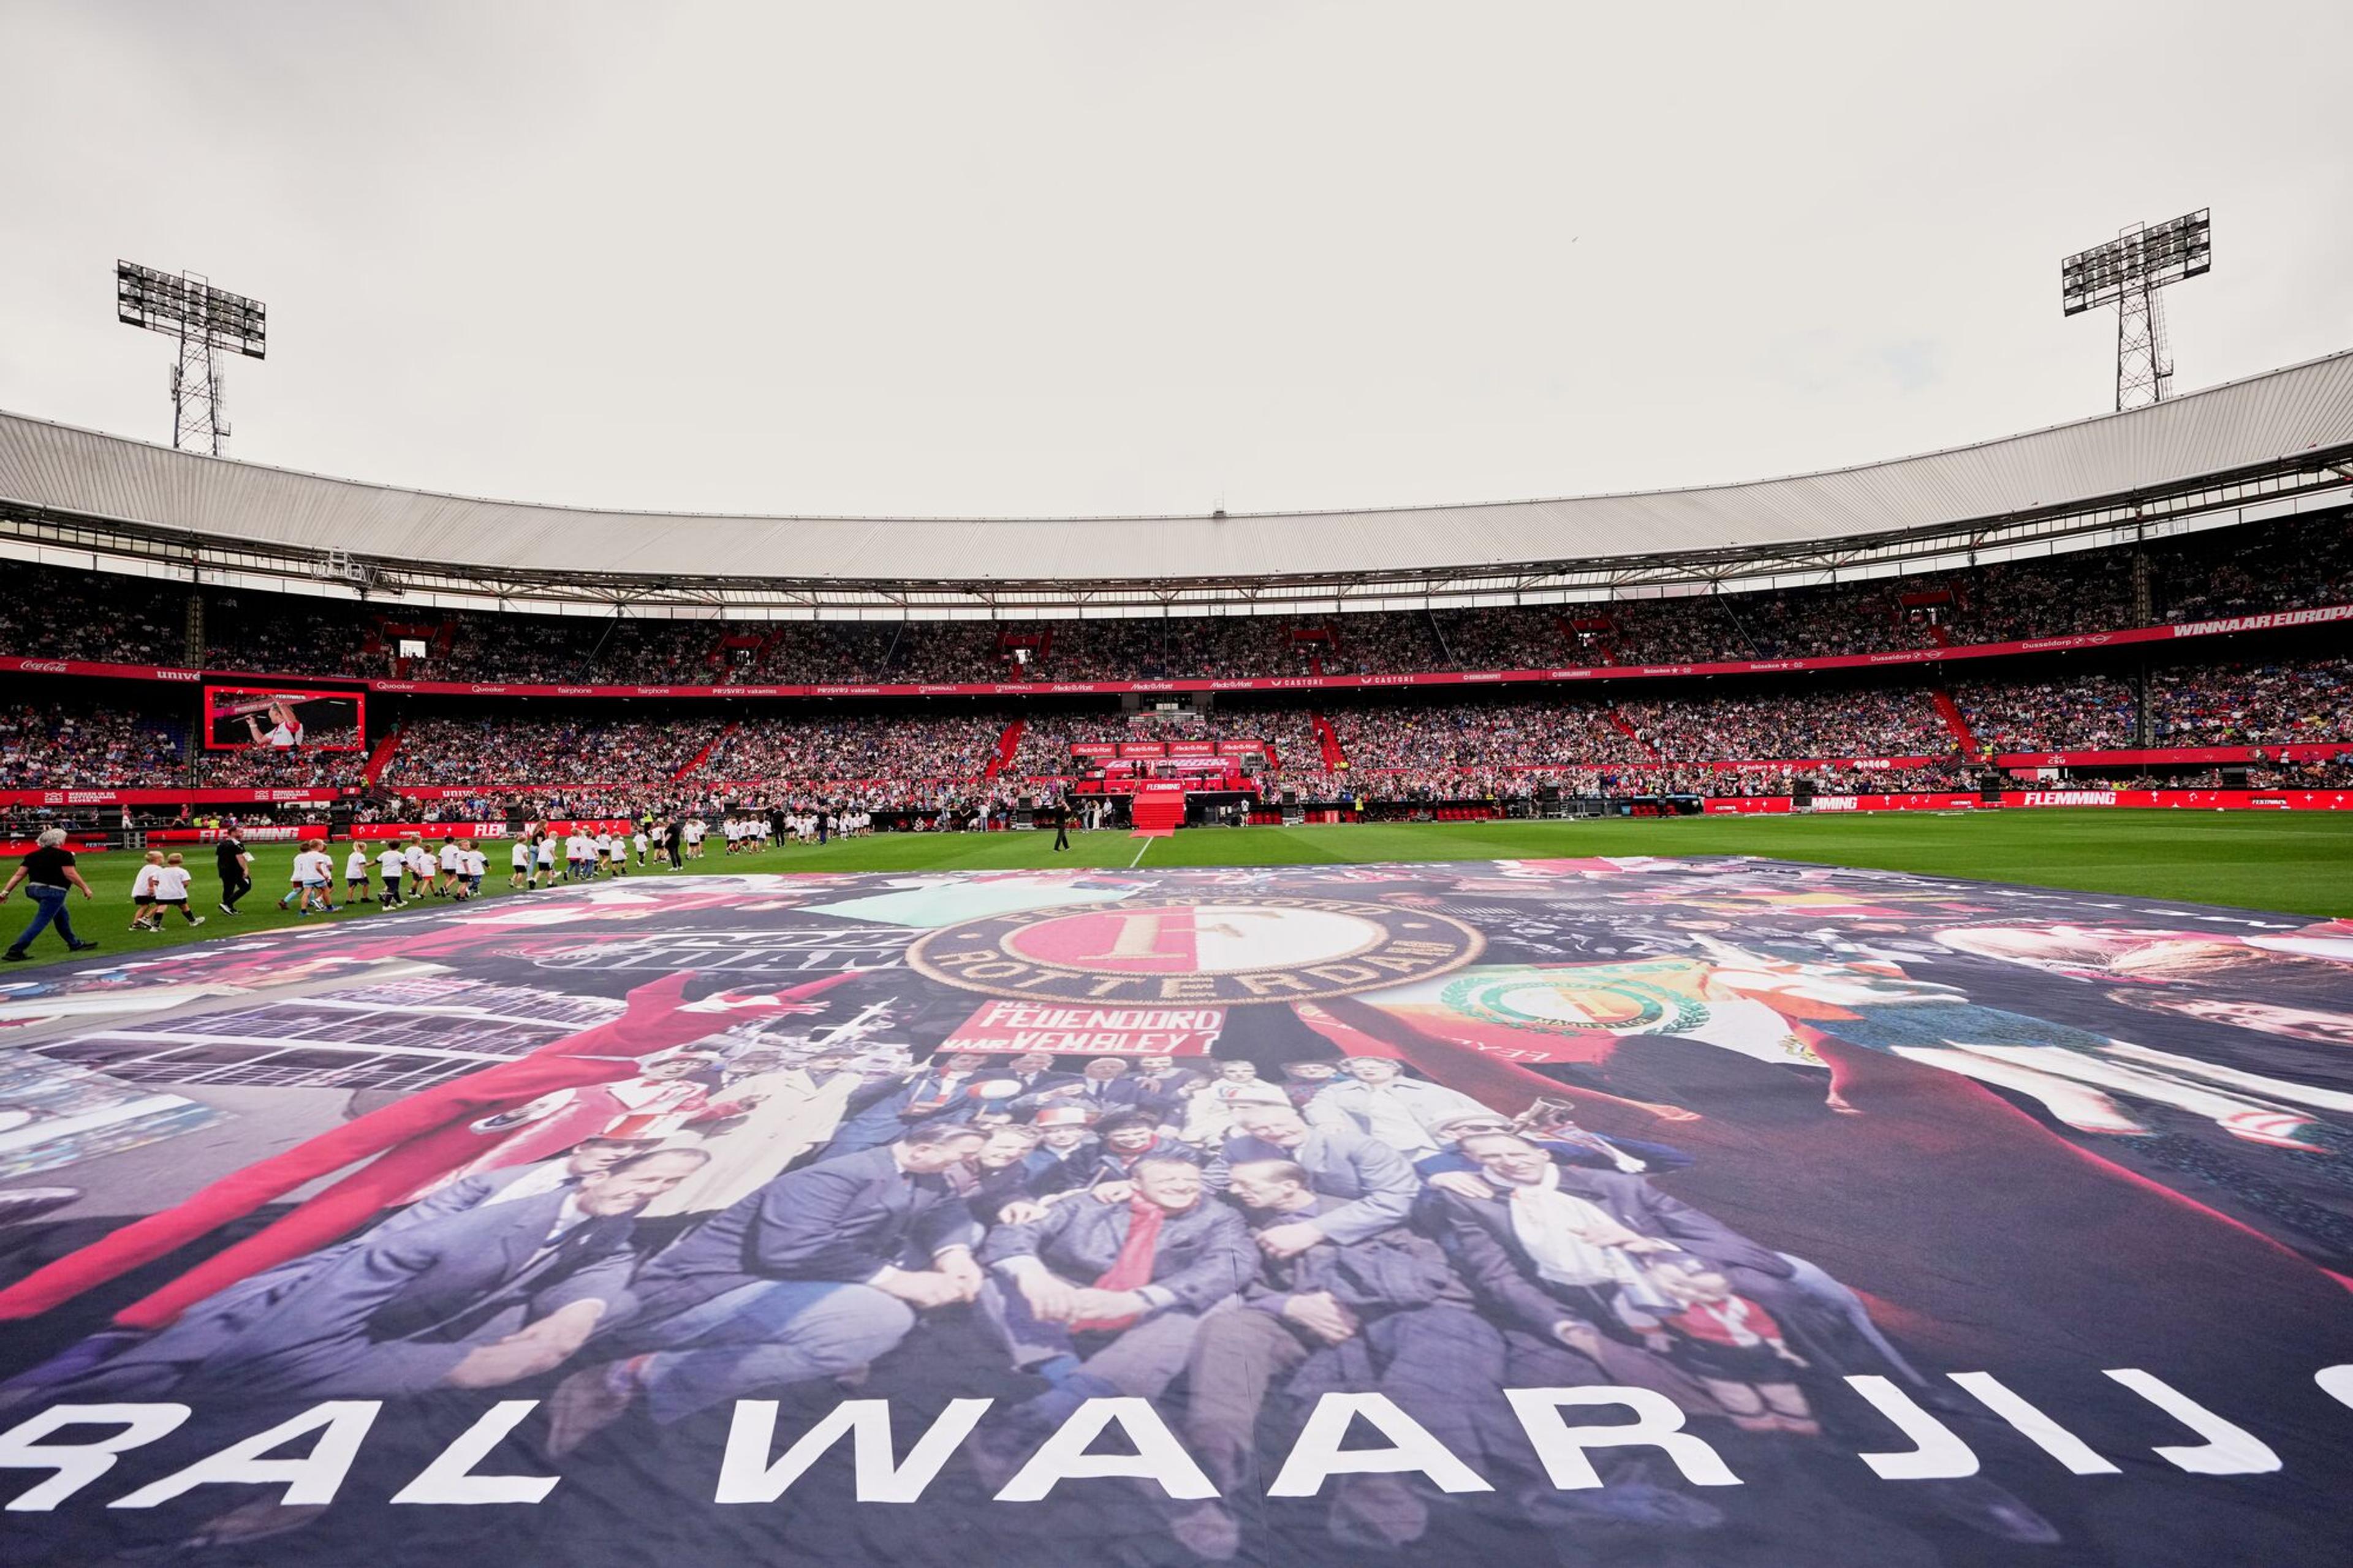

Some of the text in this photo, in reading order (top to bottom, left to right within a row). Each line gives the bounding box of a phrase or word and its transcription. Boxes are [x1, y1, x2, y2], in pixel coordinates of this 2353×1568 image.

[2174, 615, 2271, 637] WINNAAR
[2021, 640, 2072, 650] Dusseldorp
[1870, 654, 1912, 662] Dusseldorp
[376, 681, 415, 690] Quooker
[471, 684, 507, 693] Quooker
[557, 686, 592, 695] fairphone
[637, 687, 669, 695] fairphone
[1790, 797, 1858, 811] MMING
[2023, 792, 2117, 805] FLEMMING
[994, 898, 1392, 925] FEYENOORD
[934, 940, 1457, 999] ROTTERDAM
[714, 1385, 1745, 1504] WAAR
[1842, 1368, 2284, 1480] JIJ
